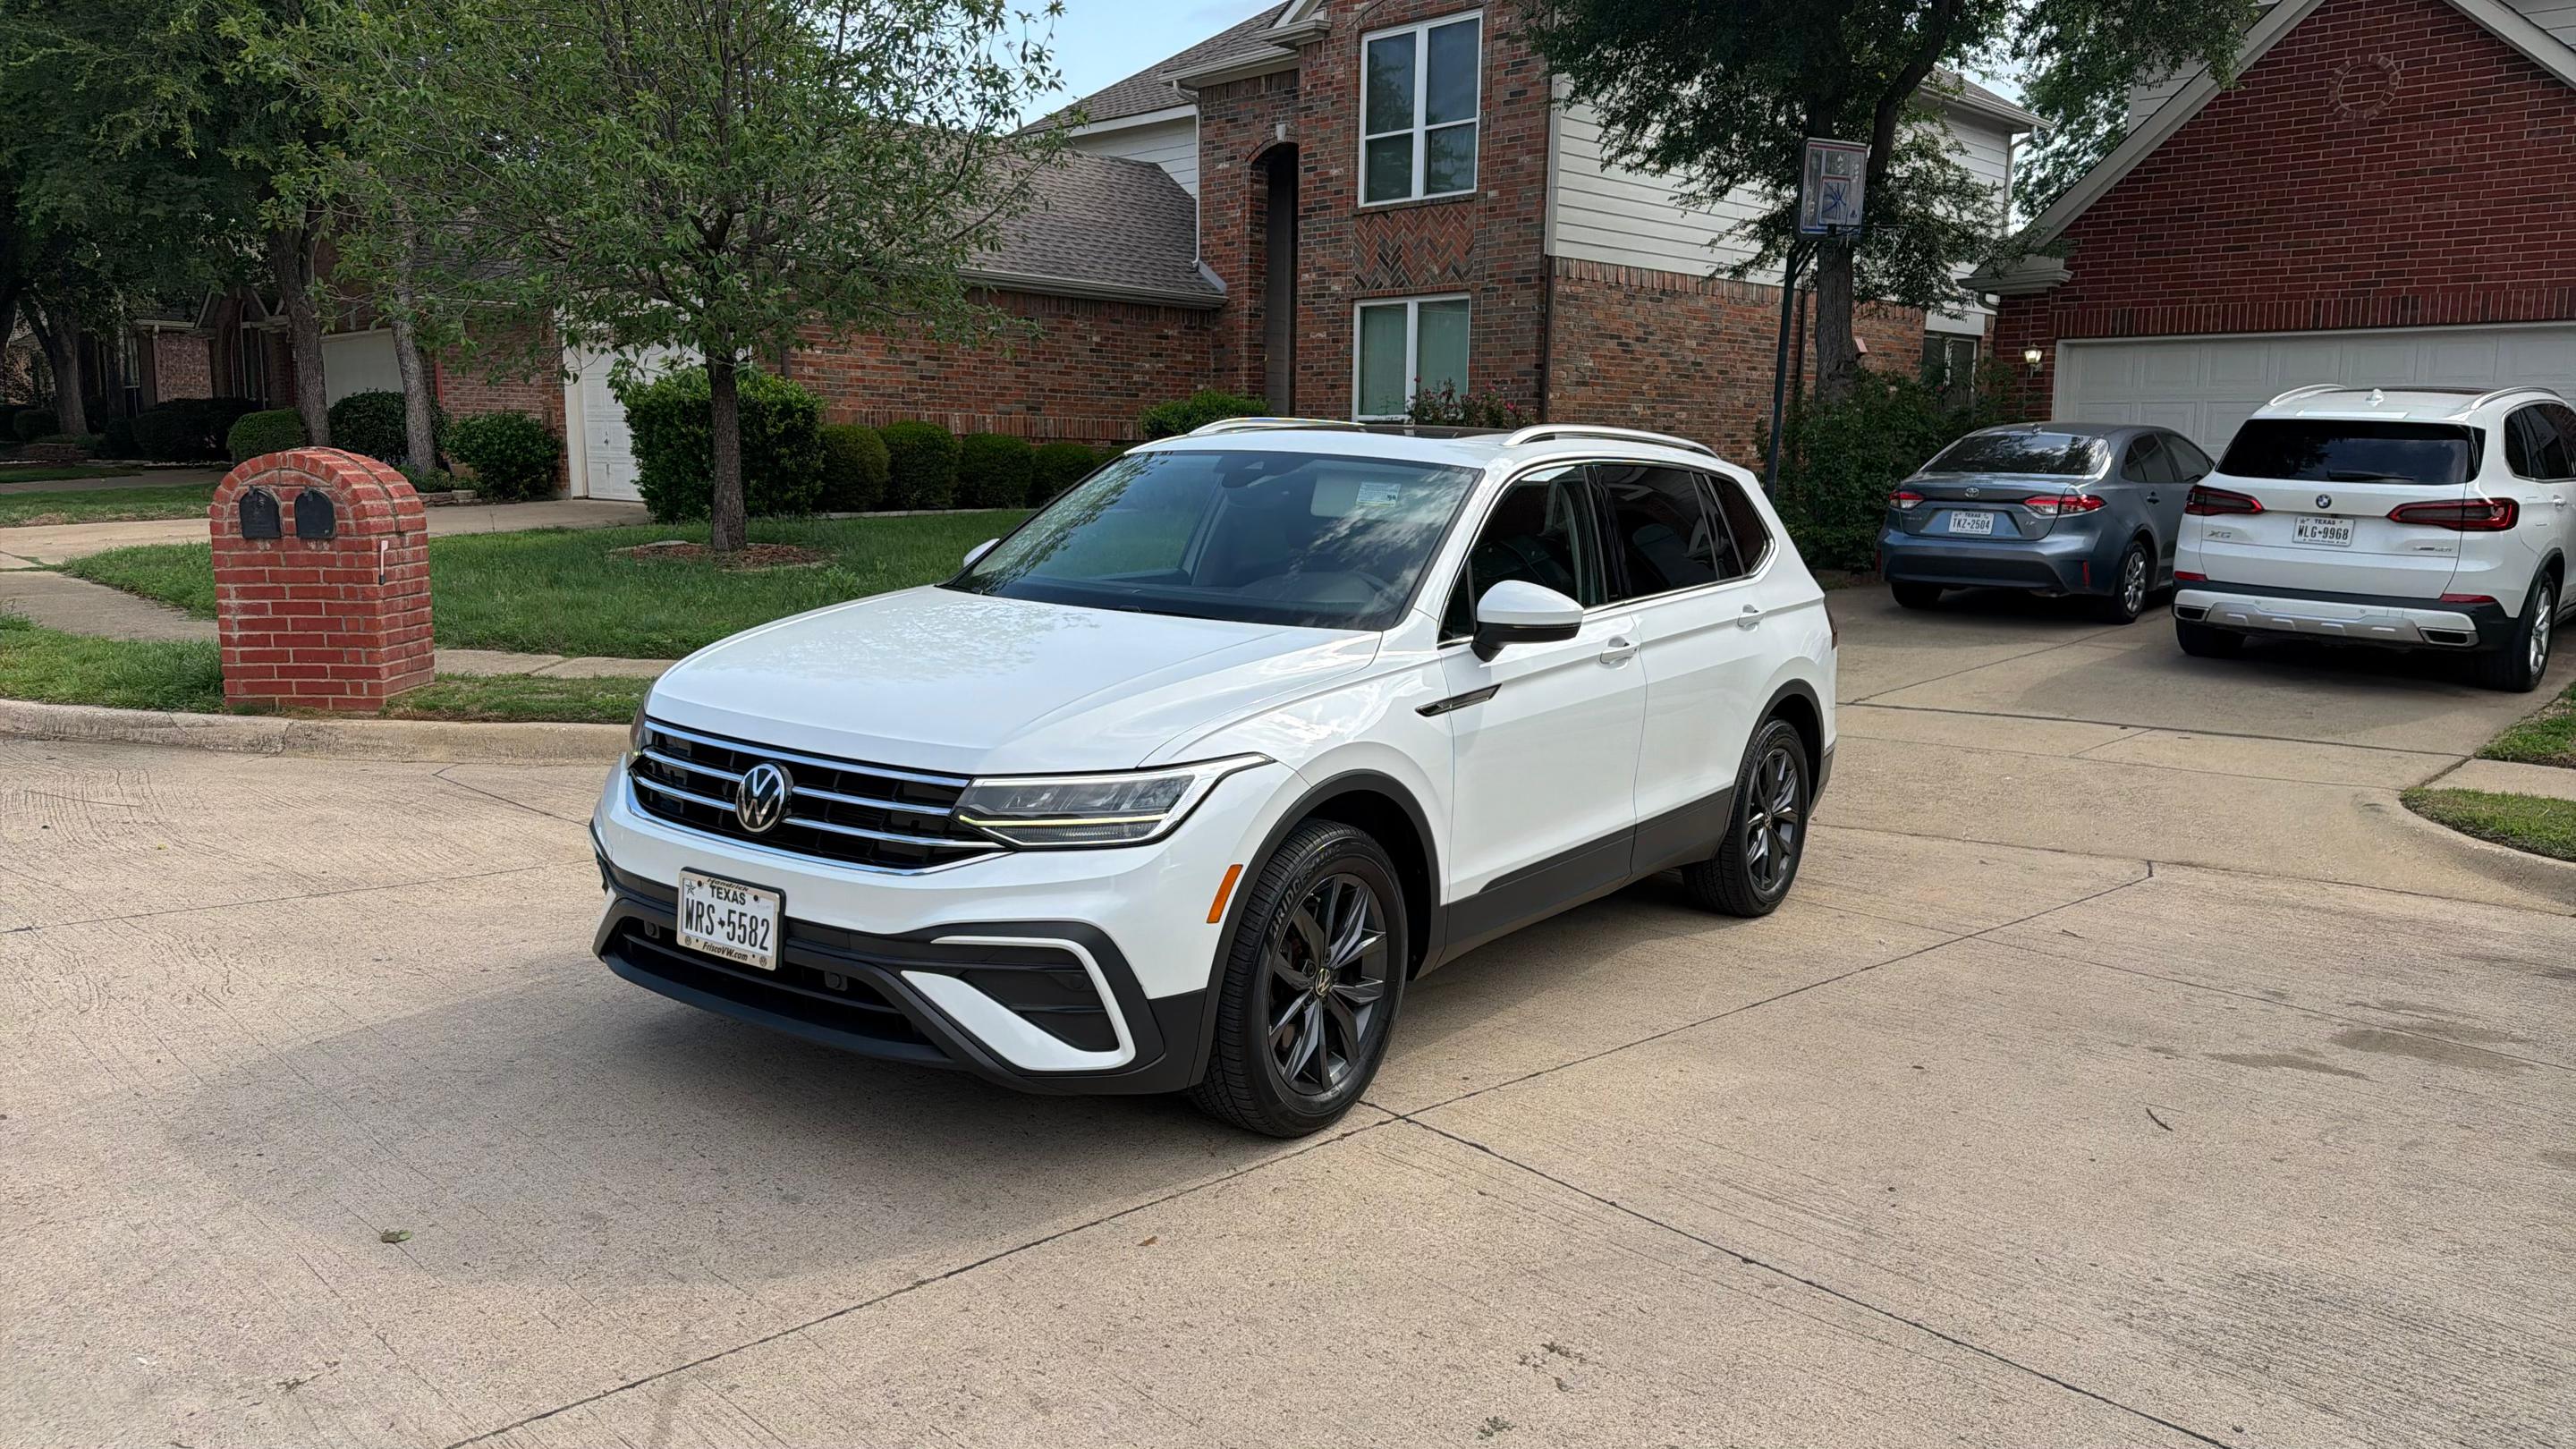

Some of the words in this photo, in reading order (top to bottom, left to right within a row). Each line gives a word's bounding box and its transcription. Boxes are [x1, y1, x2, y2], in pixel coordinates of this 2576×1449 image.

[736, 763, 784, 832] VW
[709, 885, 746, 905] TEXAS
[685, 897, 716, 936] WRS
[726, 909, 770, 952] 5582
[702, 941, 749, 962] FriscoVW.com
